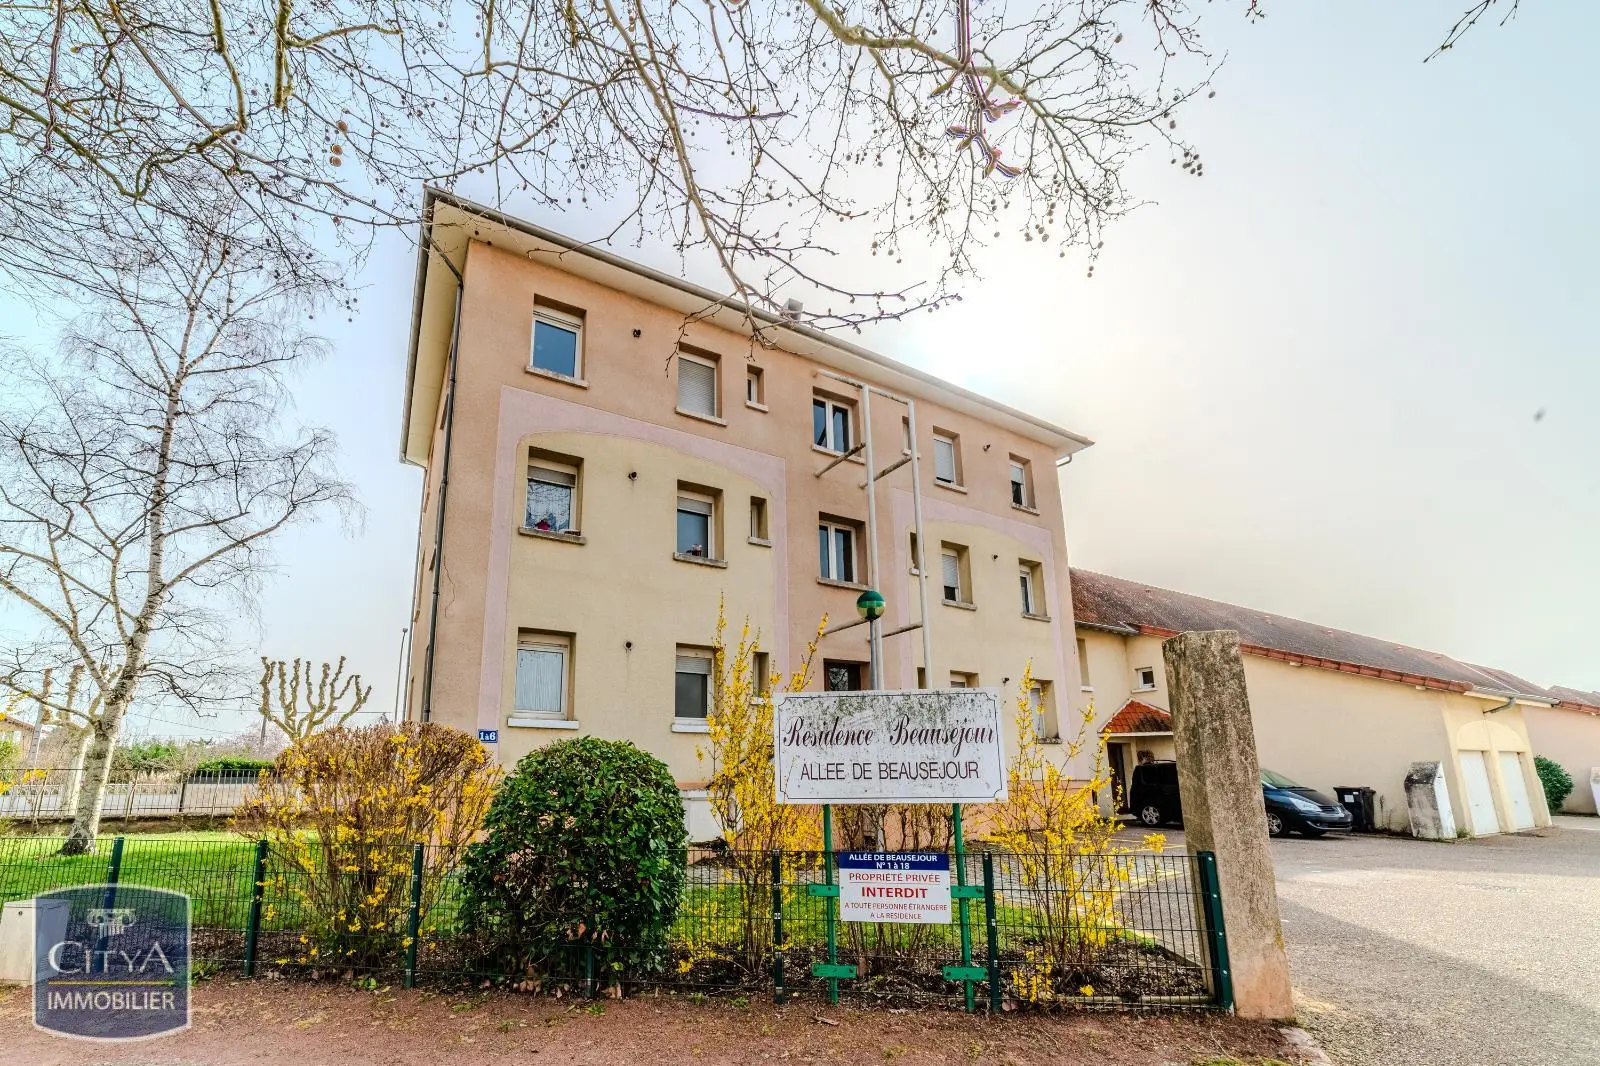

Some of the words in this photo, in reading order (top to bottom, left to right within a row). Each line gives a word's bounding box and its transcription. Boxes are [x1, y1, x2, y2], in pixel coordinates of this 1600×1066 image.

[800, 762, 845, 781] ALLEE
[852, 762, 873, 780] DE
[878, 761, 980, 780] BEAUSEJOUR
[849, 873, 903, 881] PROPRIÉTÉ
[906, 873, 940, 882] PRIVÉE
[861, 887, 928, 898] INTERDIT
